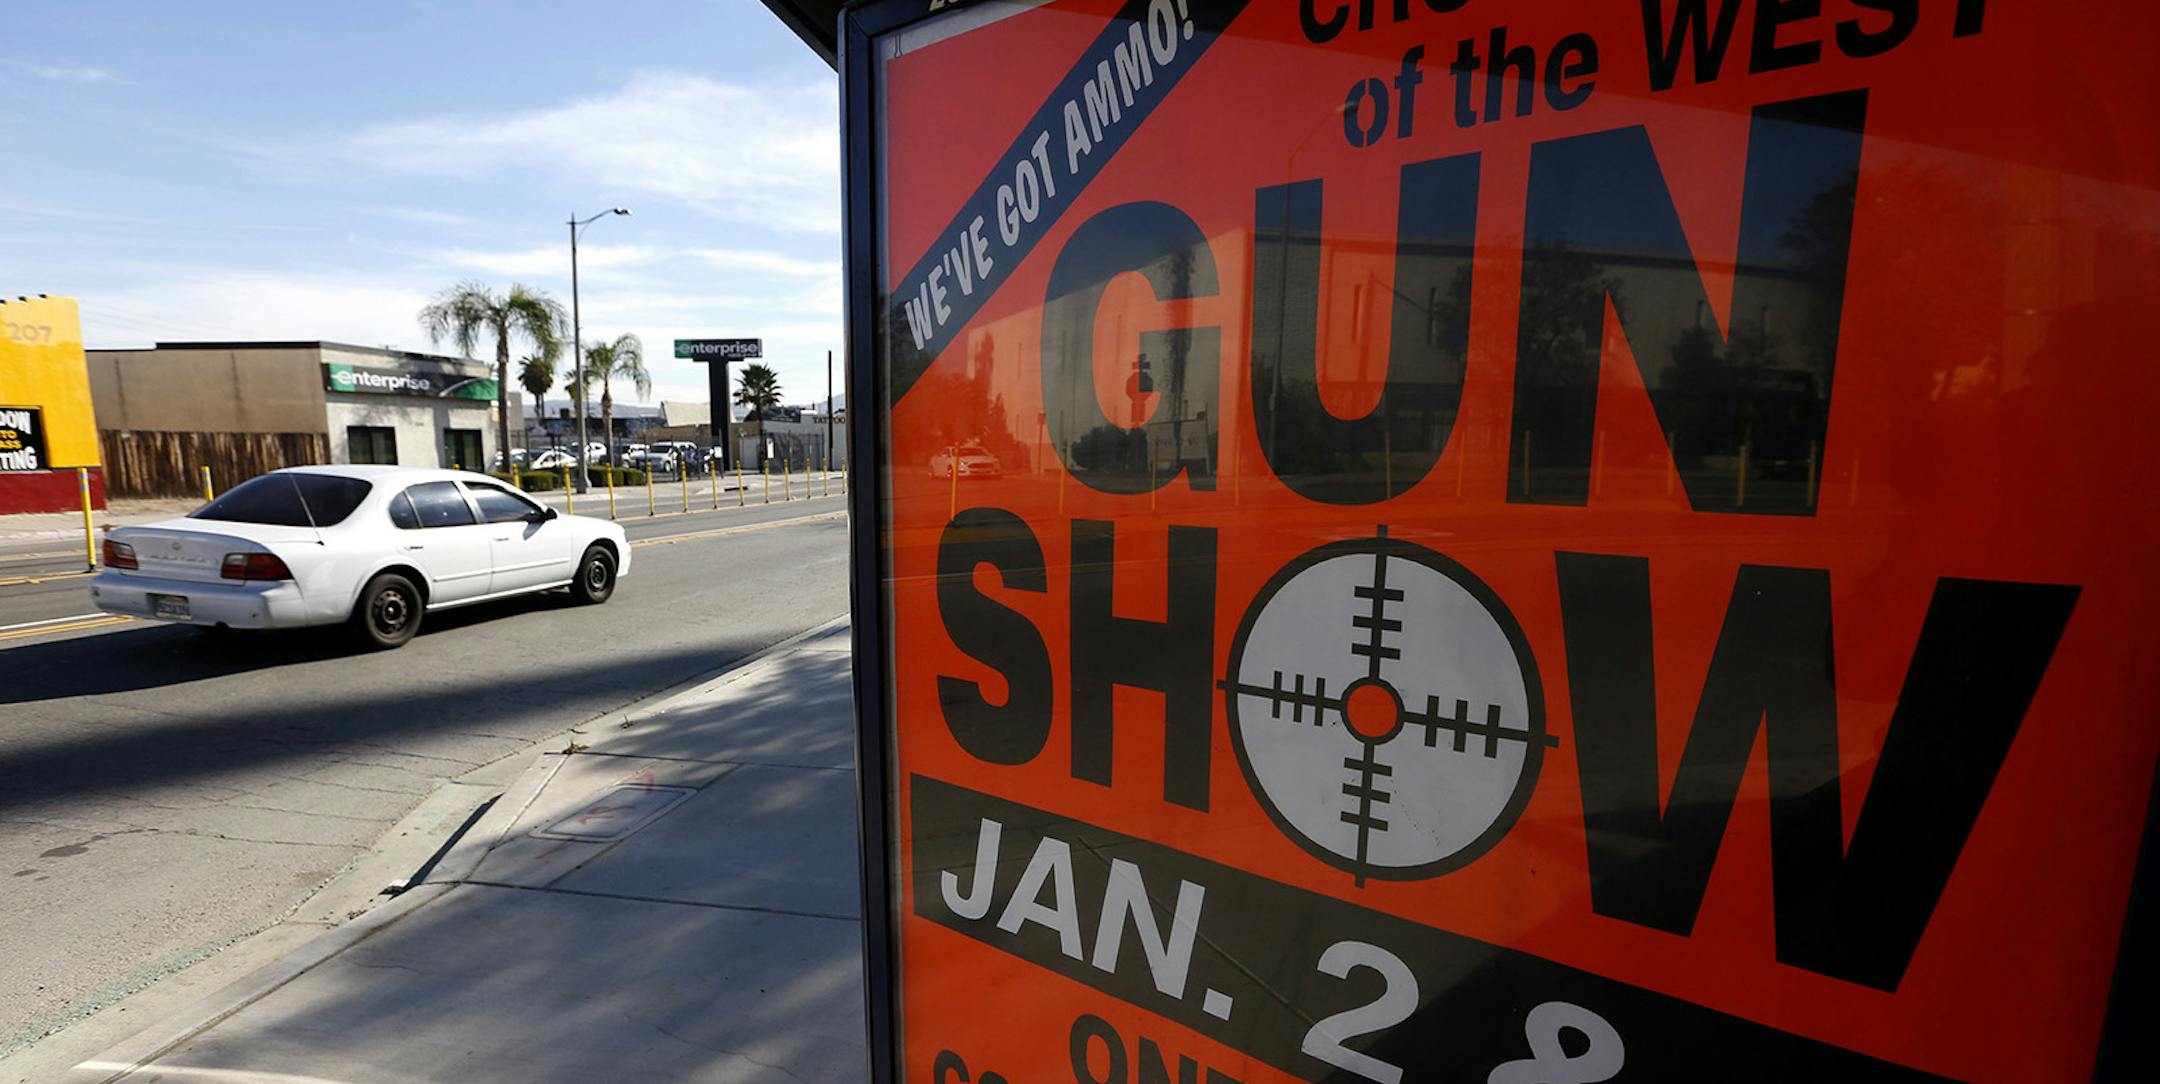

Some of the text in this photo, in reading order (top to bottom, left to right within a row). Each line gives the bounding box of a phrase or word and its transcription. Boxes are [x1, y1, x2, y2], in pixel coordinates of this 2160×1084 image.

[904, 0, 1195, 351] WE'VE GOT AMMO!
[1344, 45, 1424, 148] of
[1450, 26, 1599, 129] the
[5, 321, 53, 343] 207
[332, 370, 431, 391] enterprise
[677, 341, 758, 357] enterprise
[1041, 87, 1869, 518] GUN
[936, 507, 2083, 994] SHOW
[940, 817, 1234, 1021] JAN.
[1301, 940, 1420, 1084] 2
